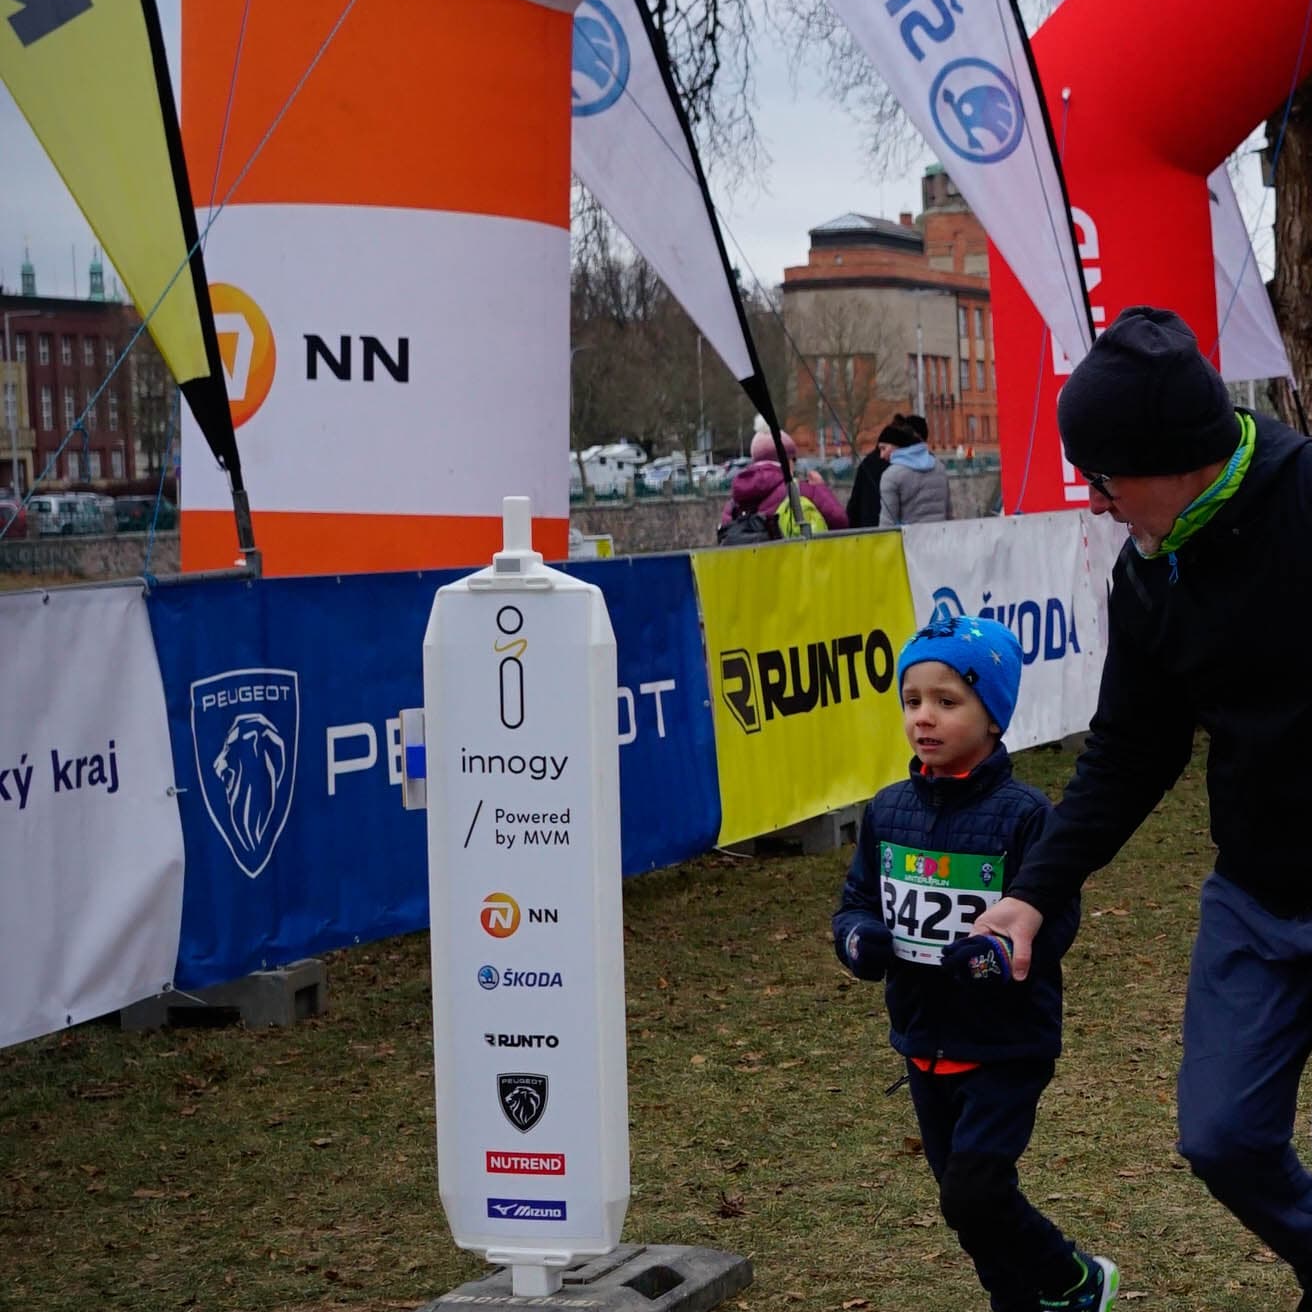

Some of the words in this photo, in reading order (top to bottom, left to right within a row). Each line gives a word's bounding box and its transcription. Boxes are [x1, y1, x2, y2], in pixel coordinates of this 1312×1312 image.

[304, 334, 409, 383] NN
[757, 629, 895, 722] RUNTO
[202, 686, 290, 713] PEUGEOT
[51, 740, 119, 794] kraj
[462, 747, 569, 780] innogy
[495, 807, 571, 824] Powered
[495, 829, 516, 847] by
[523, 830, 570, 846] MVM
[528, 908, 558, 923] NN
[883, 882, 987, 941] 3423
[502, 968, 563, 987] ŠKODA
[498, 1034, 560, 1049] RUNTO
[502, 1078, 543, 1086] PEUGEOT
[490, 1156, 562, 1171] NUTREND
